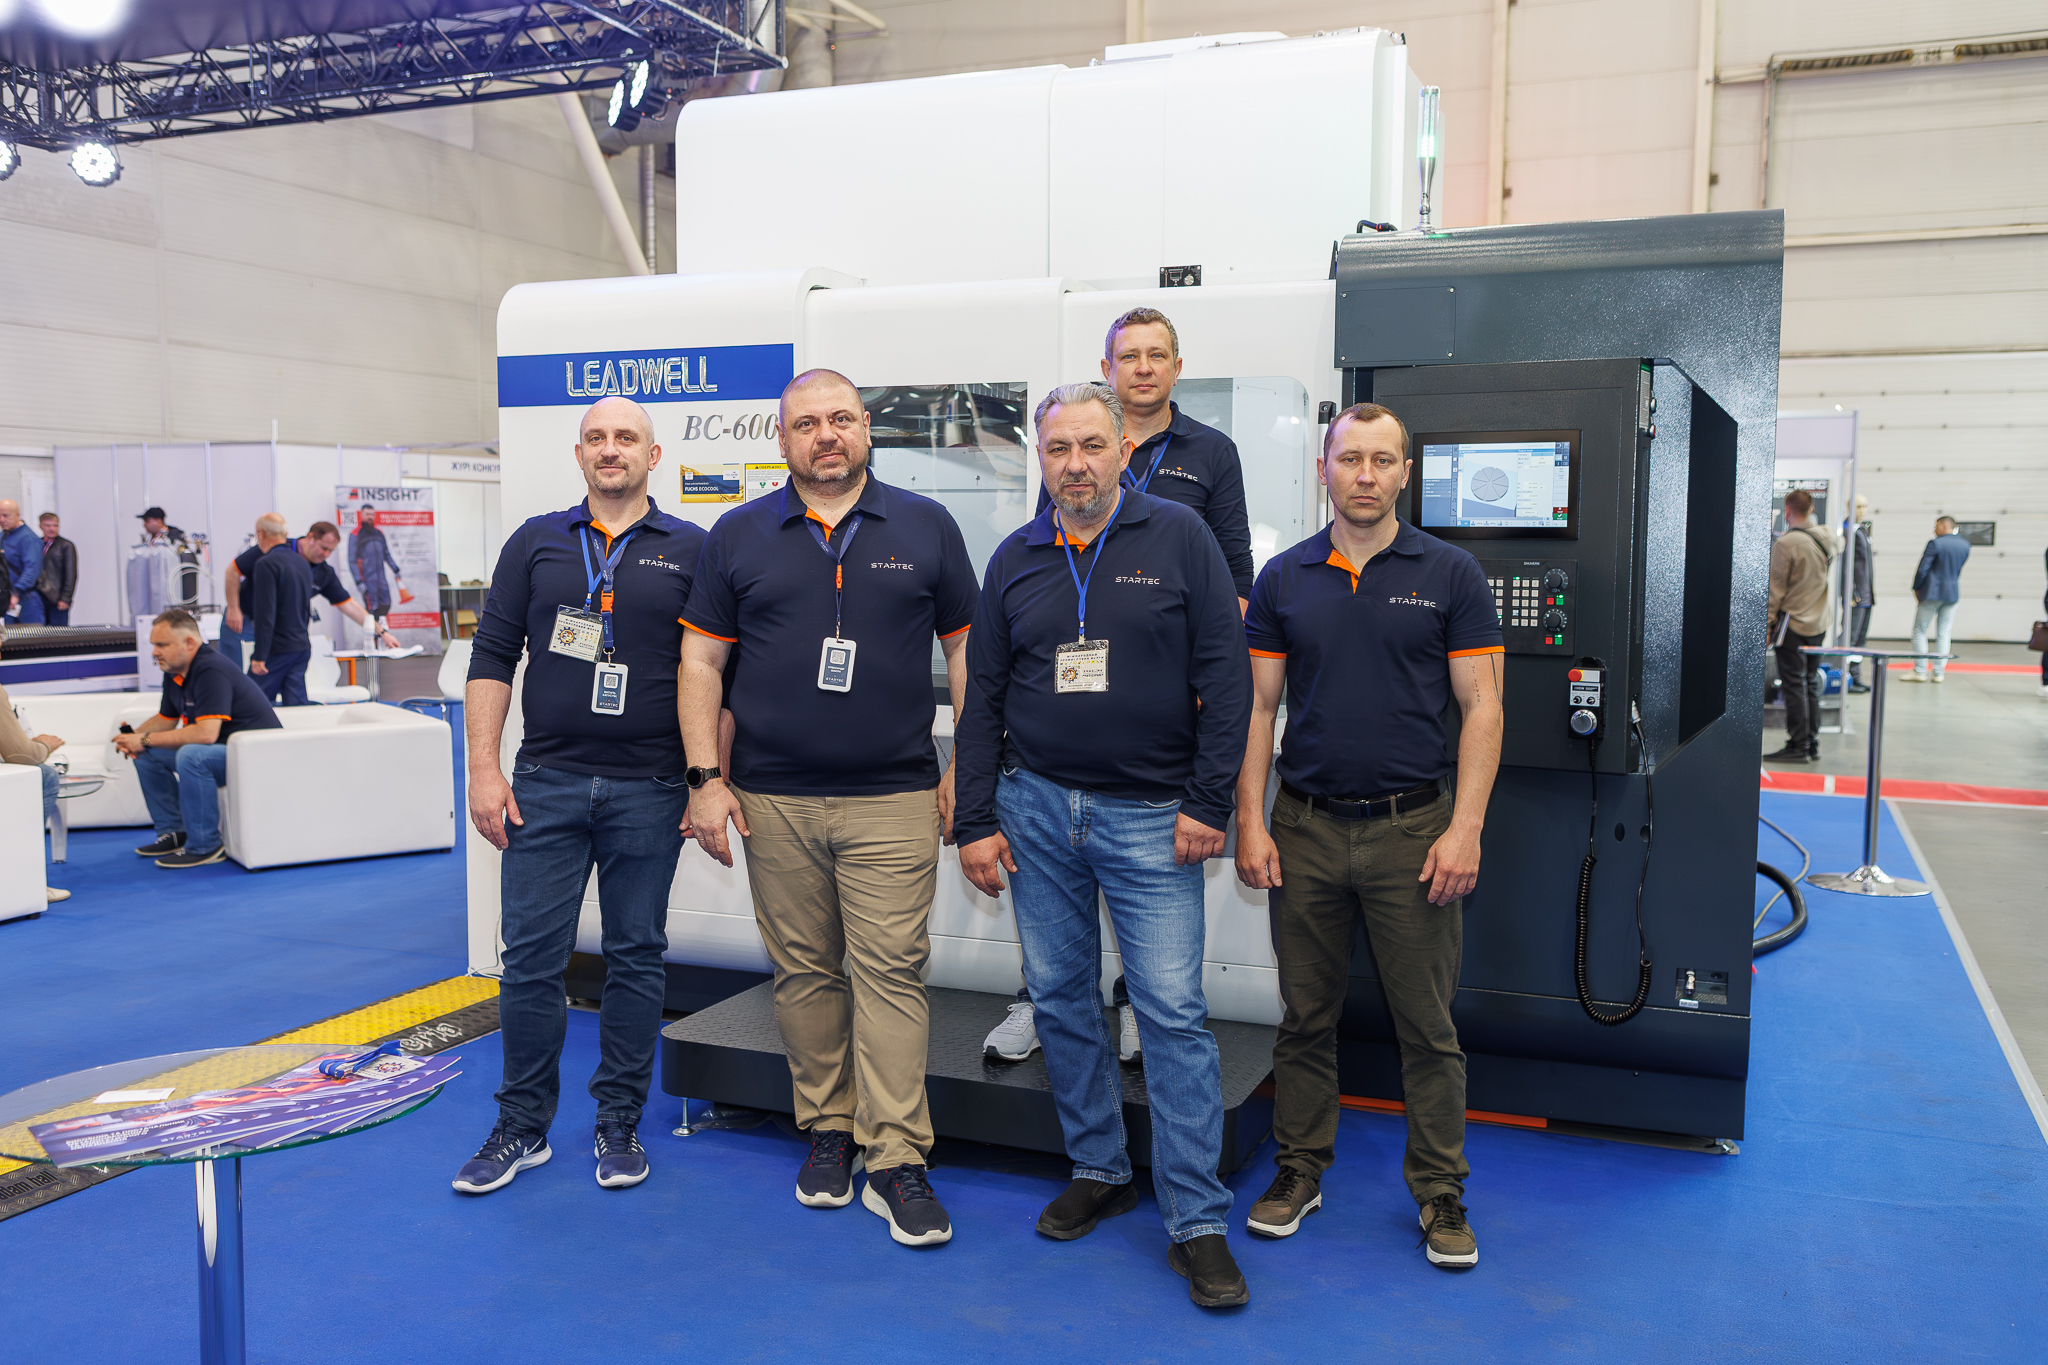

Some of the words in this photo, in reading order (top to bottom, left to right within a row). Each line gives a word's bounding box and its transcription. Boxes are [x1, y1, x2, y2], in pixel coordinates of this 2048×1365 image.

[565, 356, 718, 397] LEADWELL
[682, 413, 778, 441] BC-600
[1159, 468, 1198, 482] STARTEC
[361, 488, 420, 501] INSIGHT
[639, 558, 680, 571] STARTEC
[870, 562, 914, 571] STARTEC
[1115, 576, 1160, 585] STARTEC
[1389, 597, 1436, 608] STARTEC
[26, 1170, 59, 1187] hall
